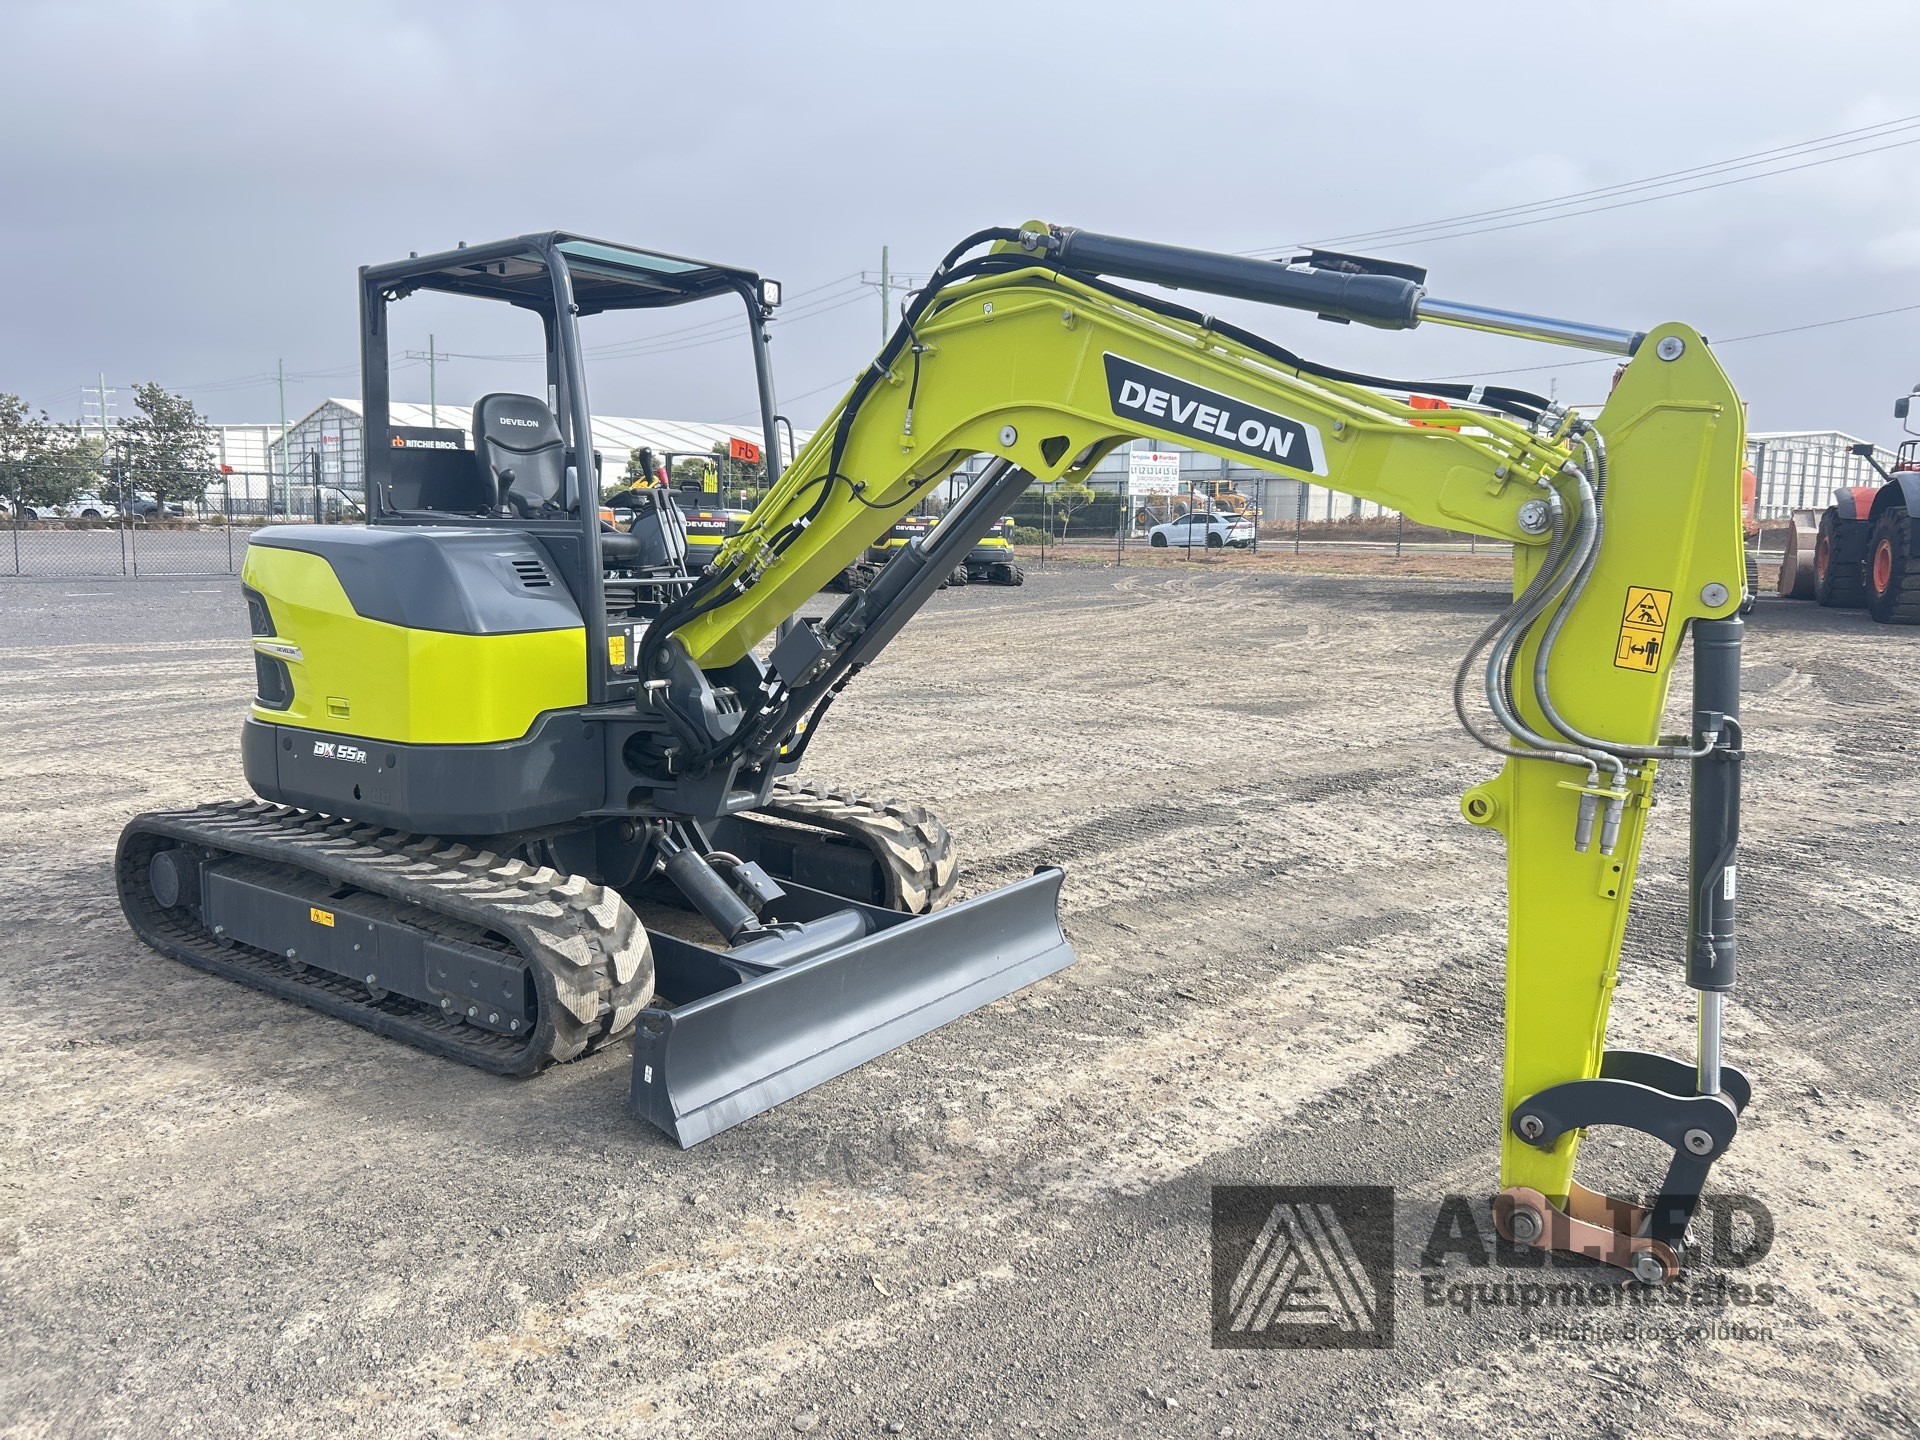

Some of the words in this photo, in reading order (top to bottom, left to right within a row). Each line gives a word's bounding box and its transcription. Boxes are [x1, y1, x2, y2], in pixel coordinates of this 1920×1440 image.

[499, 417, 539, 428] DEVELON
[1118, 379, 1295, 458] DEVELON
[406, 439, 434, 449] RITCHIE
[435, 441, 459, 450] BROS.
[738, 443, 754, 459] rb
[1131, 466, 1137, 474] L1
[1139, 466, 1146, 474] L2
[1155, 467, 1162, 475] L4
[1163, 467, 1170, 475] L5
[685, 520, 726, 528] DEVELON
[276, 646, 296, 655] DEVELON
